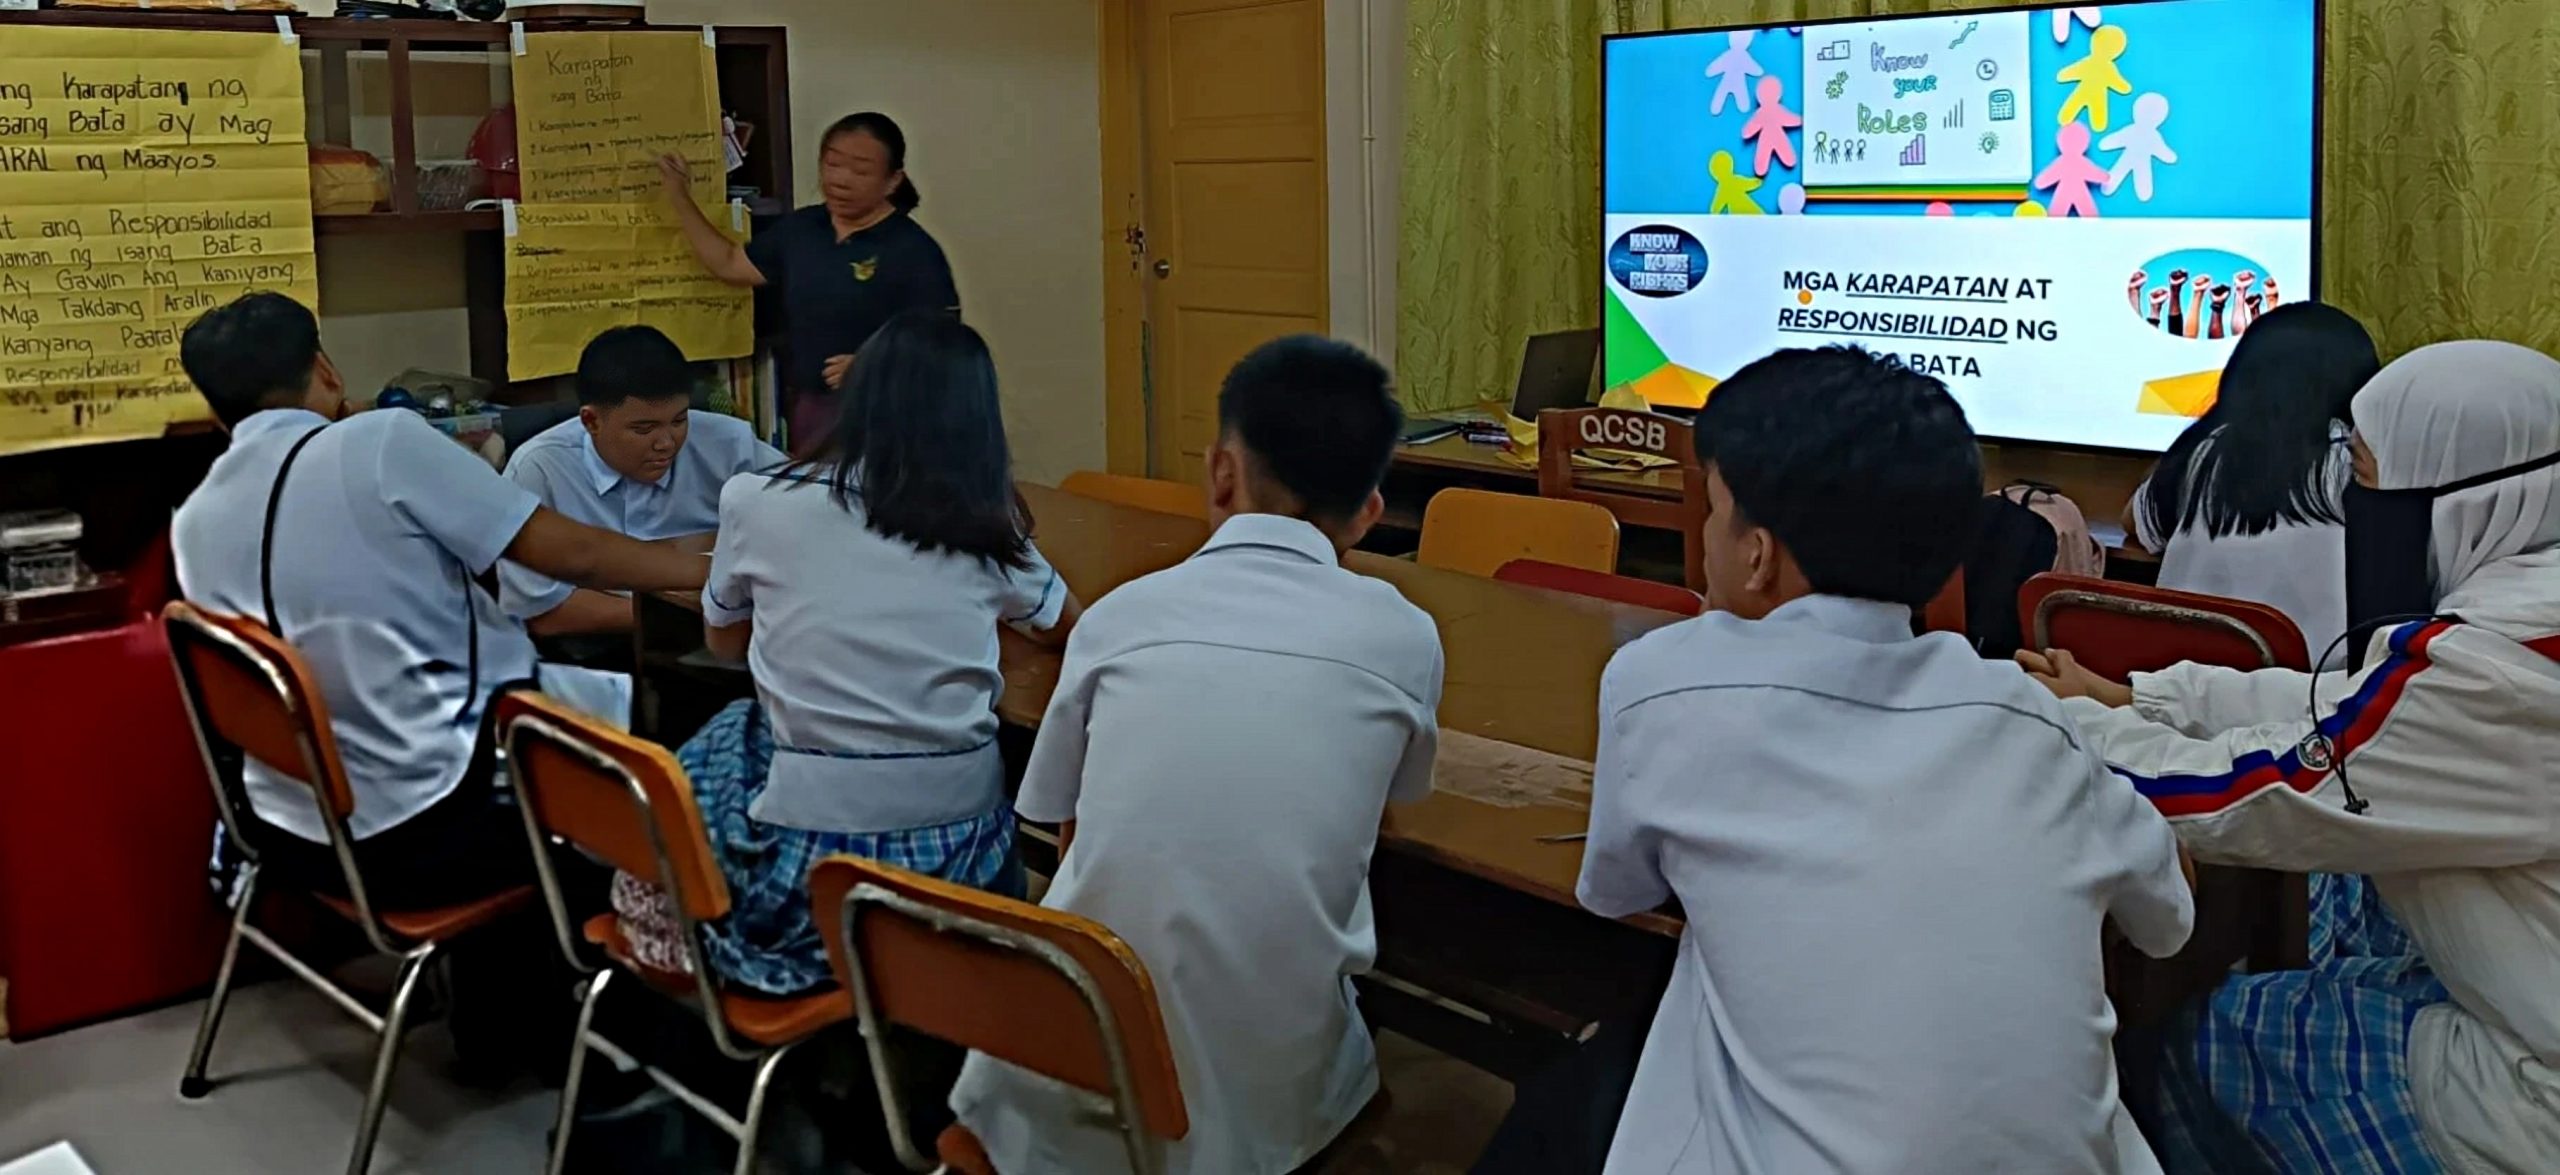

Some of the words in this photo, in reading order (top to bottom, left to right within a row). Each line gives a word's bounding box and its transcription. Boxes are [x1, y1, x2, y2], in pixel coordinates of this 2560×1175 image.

[545, 49, 634, 84] Karapatan
[1870, 41, 1929, 73] Know
[208, 79, 249, 109] ng
[69, 106, 125, 133] Bata
[220, 114, 273, 145] Mag
[76, 154, 108, 180] ng
[41, 219, 83, 242] ang
[109, 208, 272, 240] Responsibilidad
[1629, 233, 1680, 251] KNOW
[70, 247, 92, 271] ng
[1643, 253, 1689, 272] YOUR
[56, 267, 126, 292] Gawin
[143, 269, 179, 291] Ang
[1629, 271, 1689, 291] RIGHTS
[1783, 270, 1839, 292] MGA
[1845, 272, 2010, 299] KARAPATAN
[2015, 278, 2053, 300] AT
[0, 303, 40, 332] Mga
[57, 296, 144, 322] Takdang
[1777, 307, 2009, 340] RESPONSIBILIDAD
[2016, 318, 2059, 342] NG
[5, 359, 141, 388] Responsibilidad
[1910, 353, 1983, 378] BATA
[1579, 414, 1666, 451] QCSB
